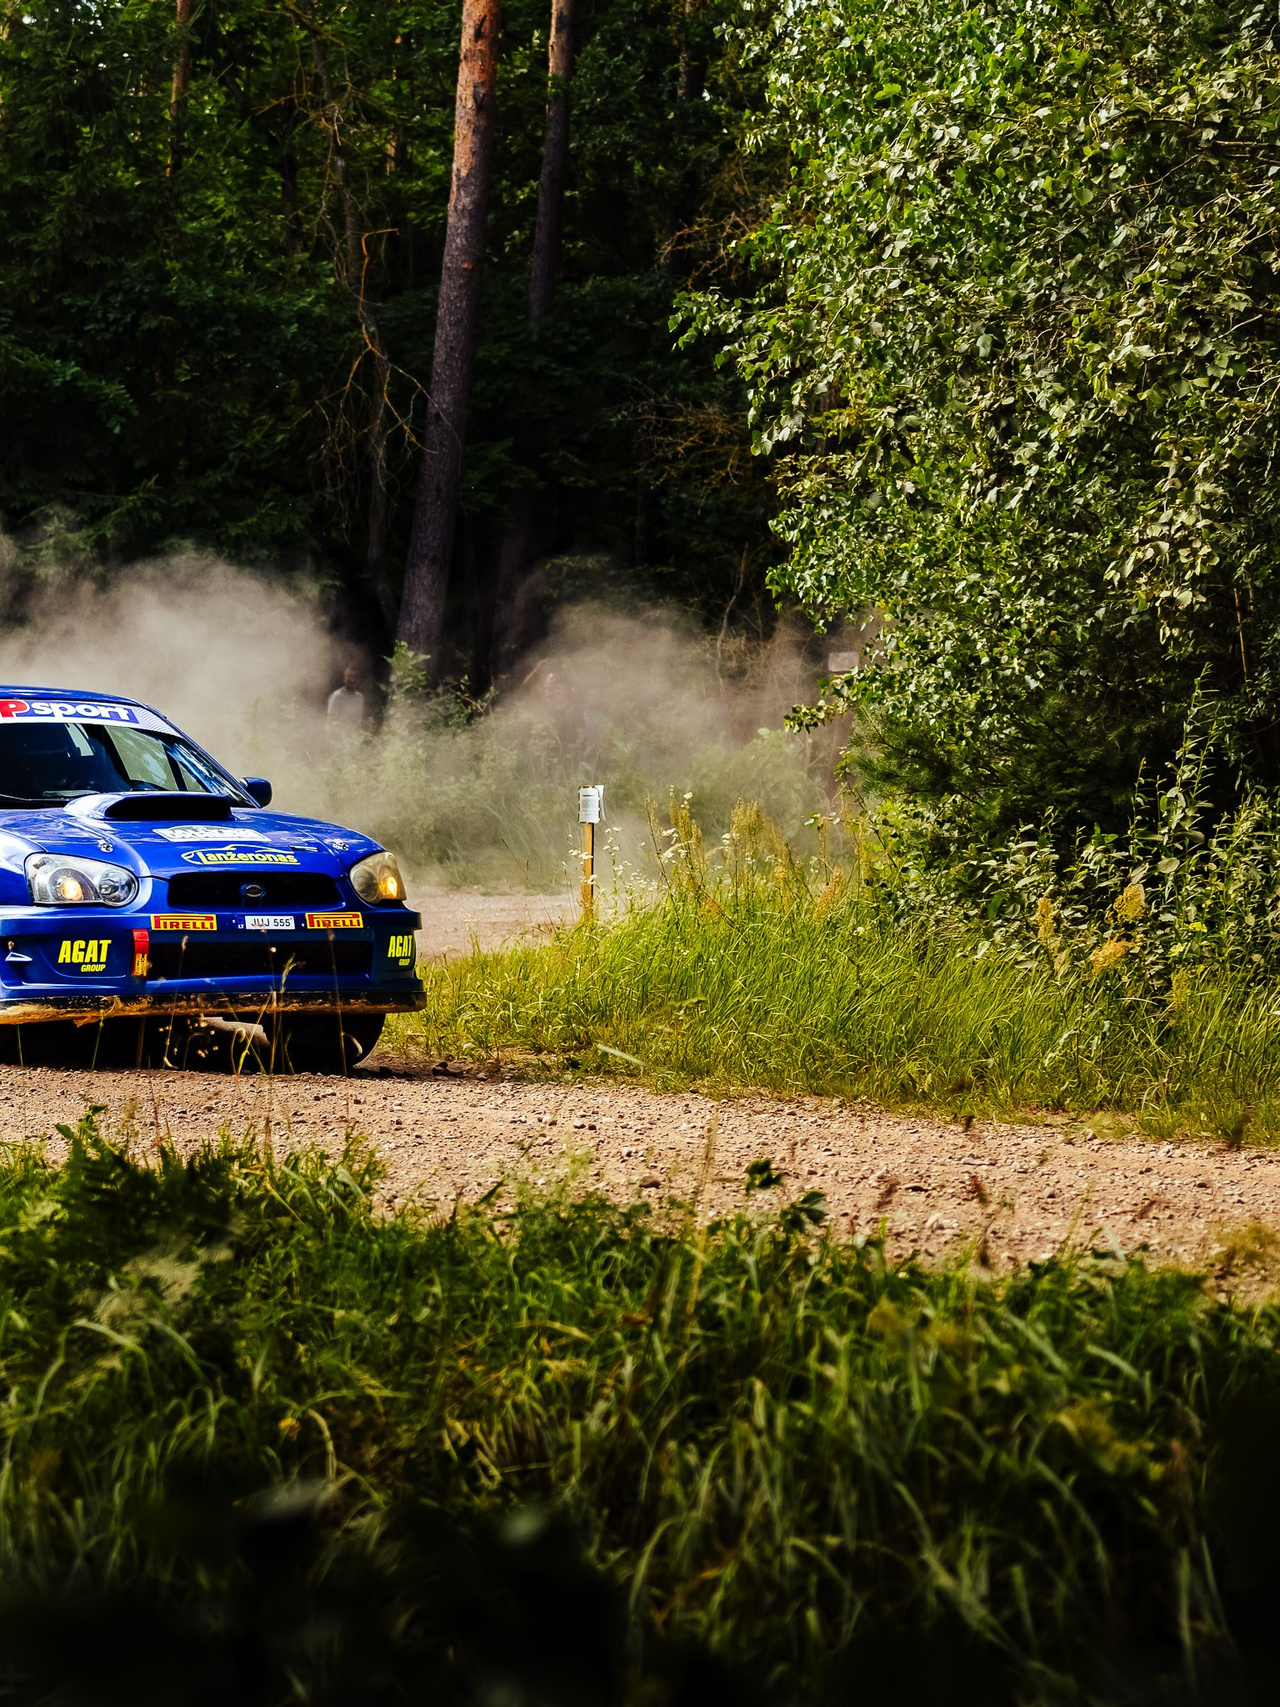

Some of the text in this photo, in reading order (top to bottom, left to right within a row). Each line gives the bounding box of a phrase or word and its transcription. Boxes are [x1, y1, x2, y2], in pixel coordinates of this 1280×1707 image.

[196, 850, 300, 865] Lanžeronas
[154, 915, 214, 930] PIRELLI
[273, 918, 291, 927] 555
[307, 913, 361, 928] PIRELLI
[58, 939, 112, 963] AGAT
[387, 935, 412, 957] AGAT
[81, 964, 106, 972] GROUP
